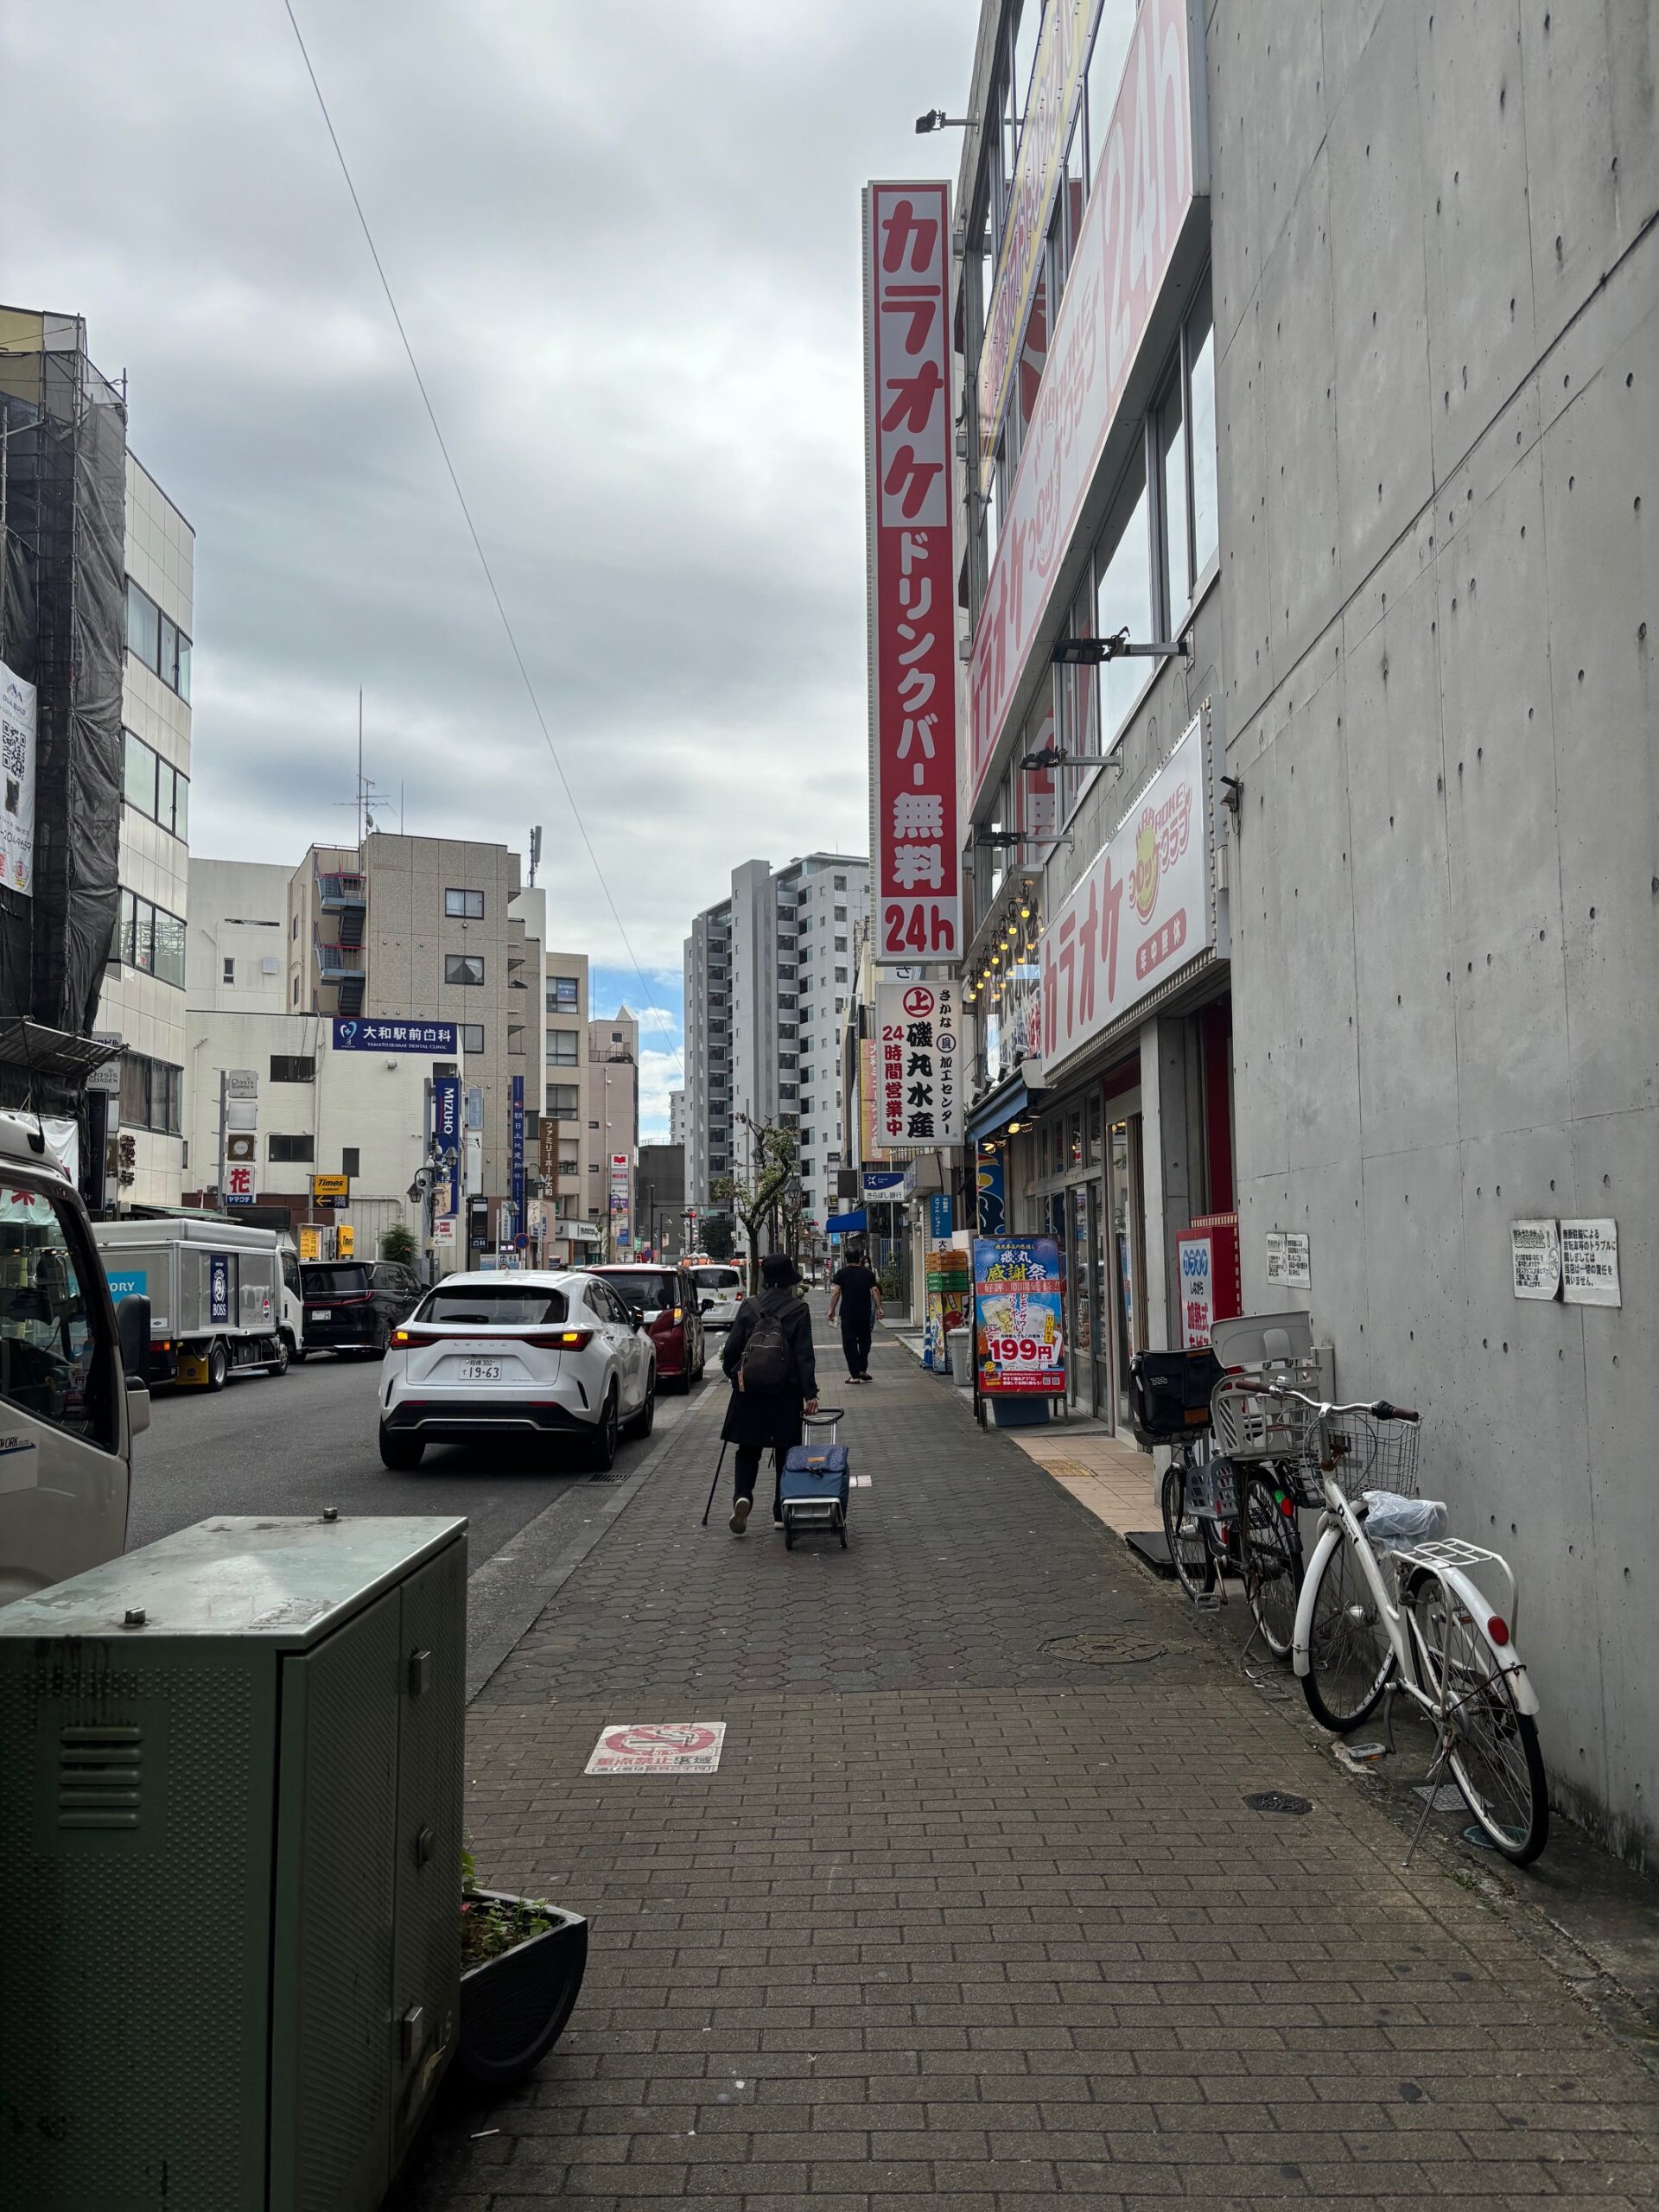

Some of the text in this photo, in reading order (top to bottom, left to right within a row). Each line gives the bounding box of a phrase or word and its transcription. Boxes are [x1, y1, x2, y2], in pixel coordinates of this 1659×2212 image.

[881, 200, 944, 518] カラオケ
[969, 517, 1027, 782] カラオケ
[893, 532, 944, 891] ドリンクバー無料
[885, 904, 955, 953] 24h
[1140, 917, 1182, 973] 年中無休
[1043, 856, 1124, 1059] カラオケ
[363, 1026, 452, 1043] 大和駅前歯科
[882, 1025, 905, 1137] 24時間営業中
[906, 1021, 935, 1139] 磯丸水産
[443, 1087, 454, 1135] MIZUHO
[229, 1168, 251, 1193] 花
[867, 1192, 902, 1200] きらぼし銀行
[987, 1263, 1047, 1281] 感謝祭
[1183, 1249, 1209, 1277] カラオケ
[213, 1304, 226, 1316] BOSS
[1020, 1293, 1028, 1332] レモンサワー
[989, 1338, 1052, 1361] 199円
[469, 1367, 499, 1378] 19-63
